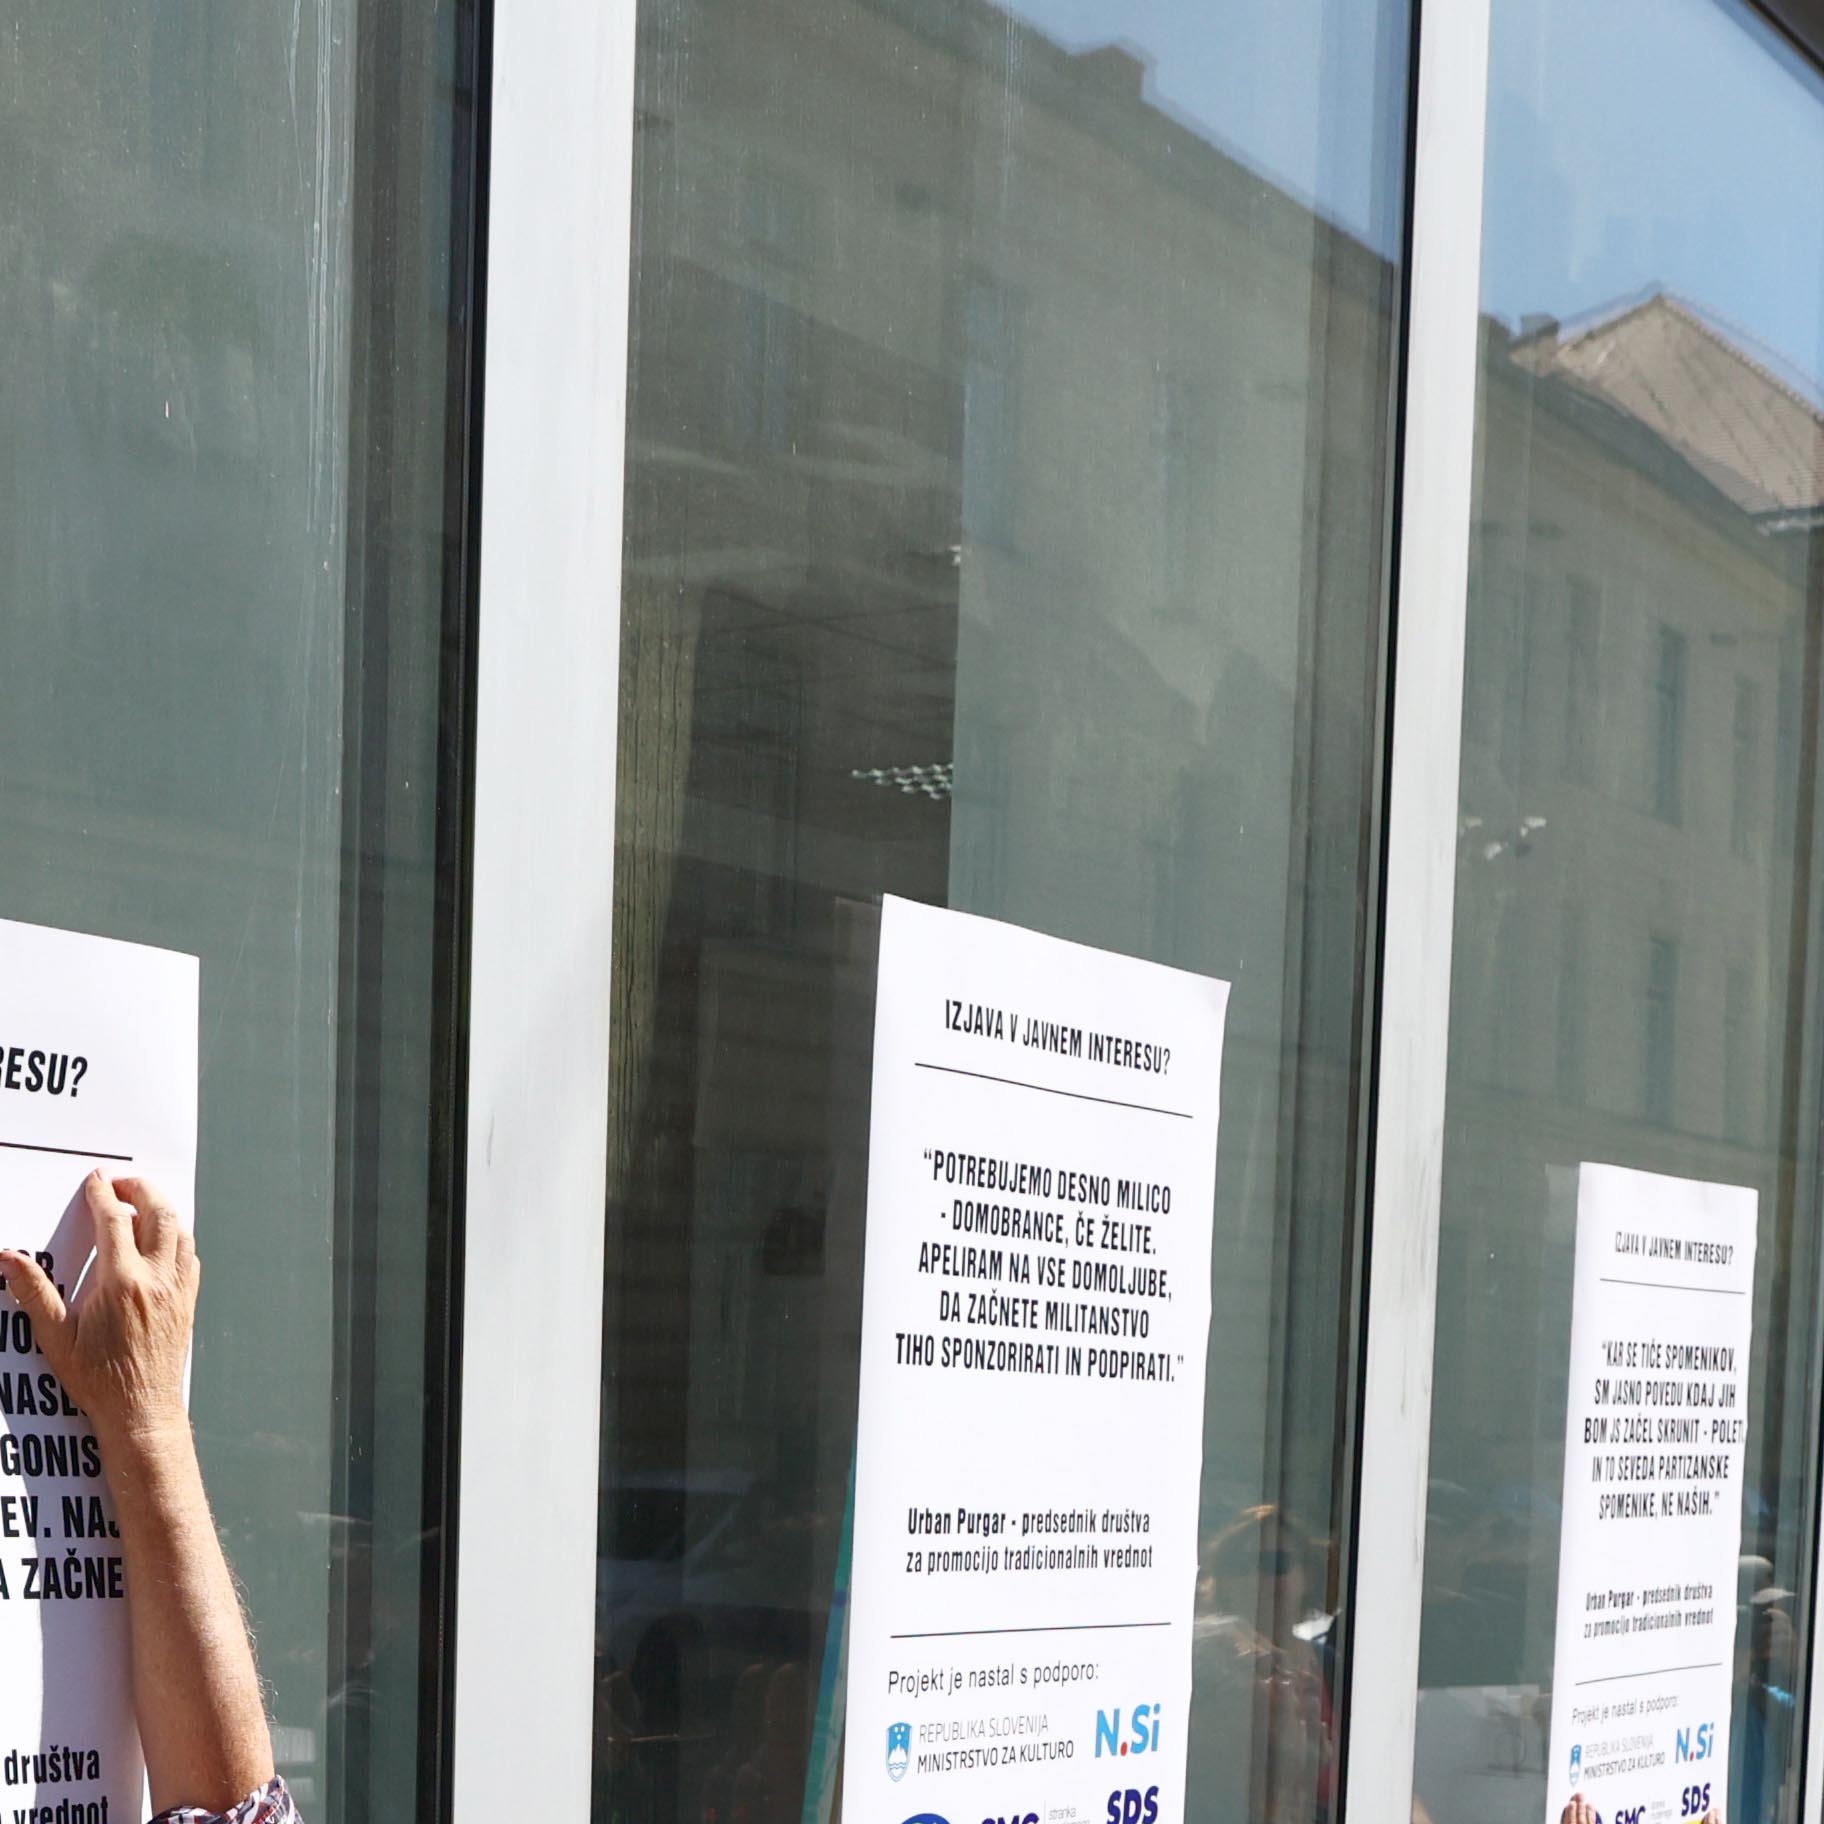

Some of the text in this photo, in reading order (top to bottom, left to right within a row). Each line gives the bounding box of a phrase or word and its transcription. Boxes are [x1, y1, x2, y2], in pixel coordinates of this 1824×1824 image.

[946, 1000, 1170, 1074] IZJAVA V JAVNEM INTERESU?
[924, 1150, 1170, 1214] “POTREBUJEMO DESNO MILICO
[953, 1200, 1068, 1245] DOMOBRANCE,
[1076, 1211, 1094, 1247] ČE
[1101, 1215, 1156, 1254] ŽELITE.
[1649, 1237, 1681, 1259] JAVNEM
[1685, 1242, 1733, 1264] INTERESU?
[918, 1242, 1171, 1300] APELIRAM NA VSE DOMOLJUBE,
[940, 1289, 1149, 1338] DA ZAČNETE MILITANSTVO
[896, 1333, 934, 1366] TIHO
[942, 1336, 1059, 1374] SPONZORIRATI
[1066, 1346, 1081, 1376] IN
[1626, 1342, 1638, 1368] SE
[1642, 1339, 1662, 1368] TIČE
[1595, 1379, 1736, 1408] SM JASNO POVEDU KDAJ JIH
[1584, 1418, 1607, 1444] BOM
[1610, 1418, 1620, 1443] JS
[1624, 1414, 1653, 1443] ZAČEL
[1658, 1418, 1700, 1443] SKRUNIT
[1592, 1455, 1729, 1482] IN TO SEVEDA PARTIZANSKE
[1662, 1492, 1674, 1516] NE
[908, 1508, 951, 1534] Urban
[958, 1508, 1006, 1537] Purgar
[1022, 1509, 1096, 1536] predsednik
[1102, 1509, 1150, 1533] društva
[906, 1544, 1152, 1575] za promocijo tradicionalnih vrednot
[888, 1661, 1098, 1698] Projekt je nastal s podporo:
[920, 1720, 986, 1743] REPUBLIKA
[989, 1714, 1048, 1738] SLOVENIJA
[4, 1742, 103, 1789] društva
[918, 1740, 1074, 1773] MINISTRSTVO ZA KULTURO
[1681, 1783, 1710, 1816] SDS
